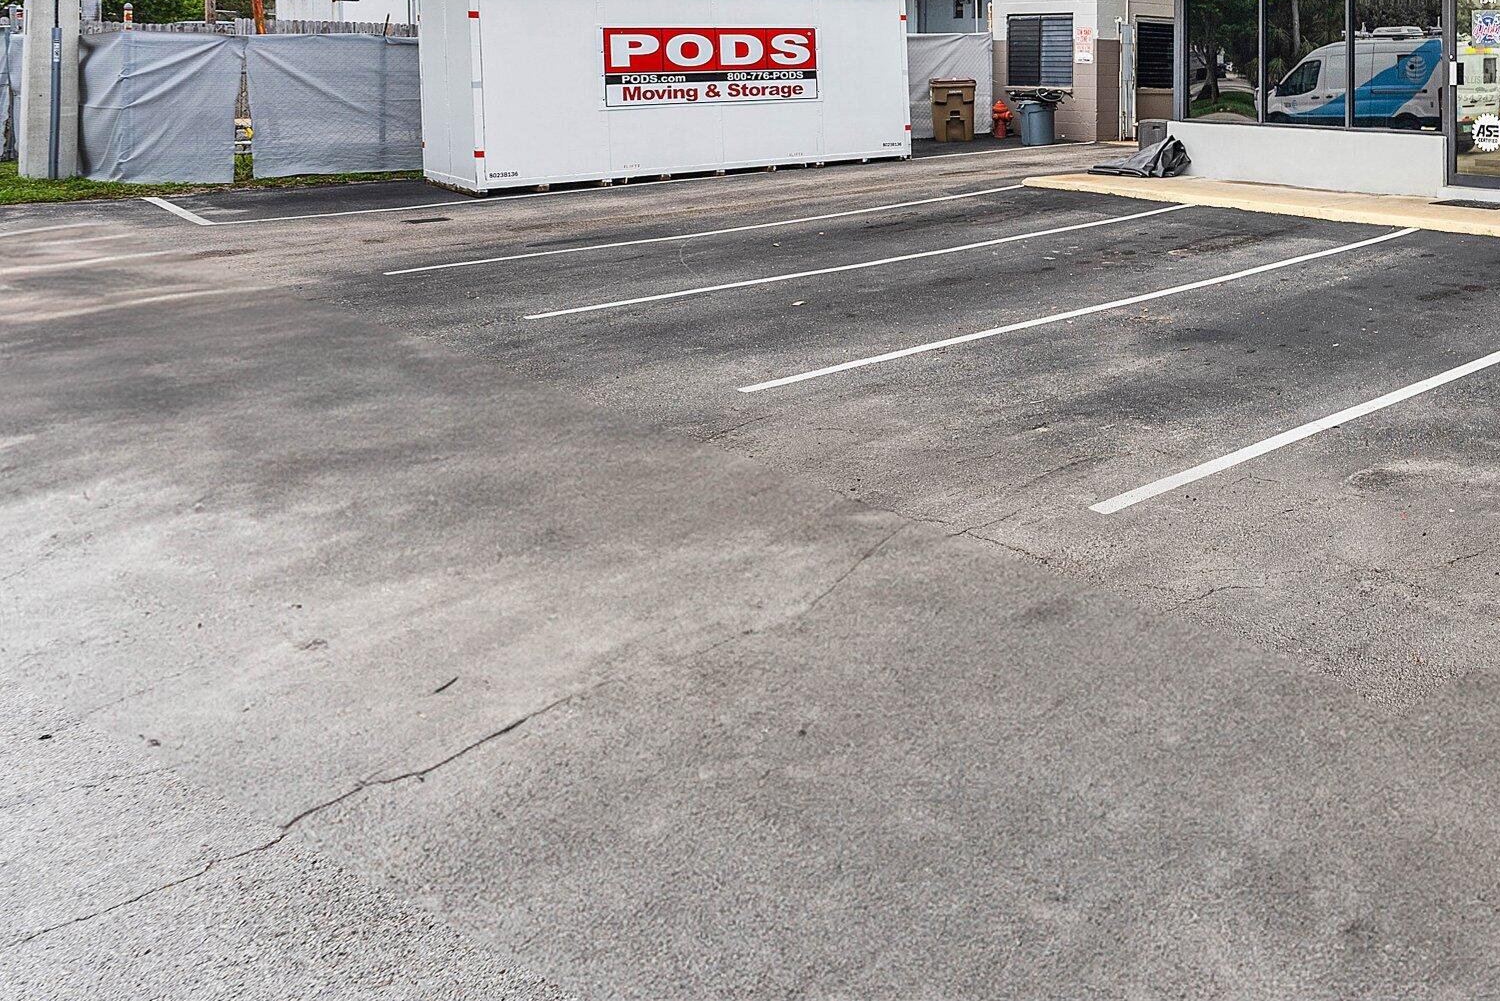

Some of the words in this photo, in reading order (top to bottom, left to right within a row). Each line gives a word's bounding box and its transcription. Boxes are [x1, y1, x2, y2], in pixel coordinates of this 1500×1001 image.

[609, 33, 811, 68] PODS
[621, 74, 686, 84] PODS.com
[727, 71, 804, 81] 800-776-PODS
[622, 85, 698, 101] Moving
[705, 84, 721, 98] &
[727, 83, 804, 97] Storage
[1476, 124, 1499, 137] ASE
